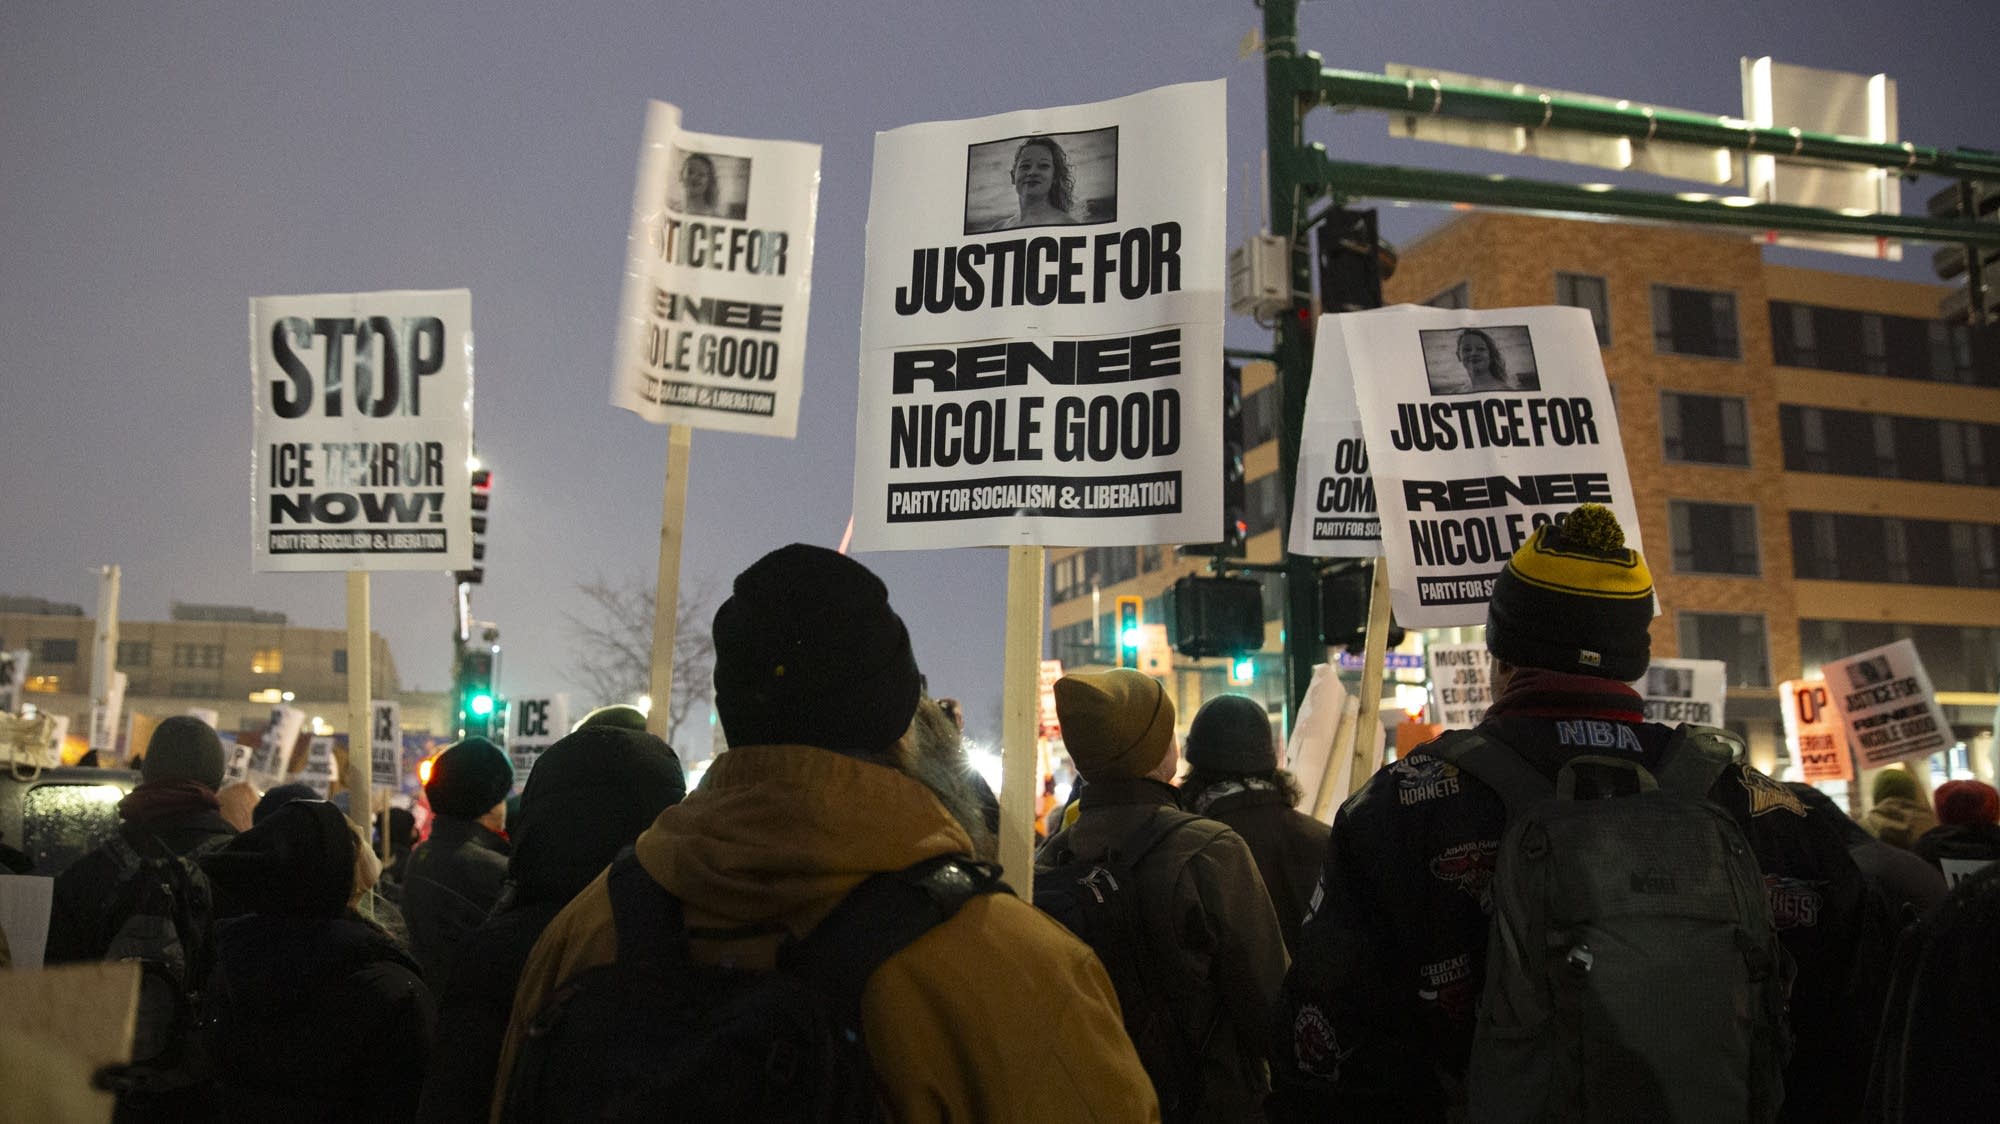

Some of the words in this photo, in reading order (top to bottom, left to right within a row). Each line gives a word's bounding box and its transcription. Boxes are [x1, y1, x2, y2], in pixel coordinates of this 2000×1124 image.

[727, 227, 788, 277] FOR
[895, 236, 1086, 316] JUSTICE
[1093, 221, 1181, 304] FOR
[655, 287, 783, 333] ENEE
[269, 315, 445, 419] STOP
[697, 332, 779, 381] GOOD
[892, 328, 1181, 395] RENEE
[890, 396, 1044, 469] NICOLE
[1053, 388, 1181, 463] GOOD
[1390, 398, 1532, 452] JUSTICE
[1528, 396, 1600, 448] FOR
[270, 442, 314, 488] ICE
[321, 441, 444, 487] TERROR
[1335, 438, 1369, 475] OU
[269, 492, 445, 524] NOW!
[891, 489, 939, 515] PARTY
[940, 488, 970, 512] FOR
[972, 484, 1056, 511] SOCIALISM
[1058, 485, 1081, 510] &
[1083, 480, 1176, 510] LIBERATION
[1402, 472, 1613, 512] RENEE
[373, 534, 387, 550] &
[1315, 521, 1345, 537] PARTY
[1345, 521, 1365, 537] FOR
[1409, 513, 1526, 566] NICOLE
[1420, 582, 1458, 601] PARTY
[1459, 579, 1485, 599] FOR
[1435, 650, 1480, 666] MONEY
[519, 700, 550, 736] ICE
[1684, 702, 1713, 723] FOR
[1556, 719, 1644, 753] NBA
[1399, 777, 1460, 806] HORNETS
